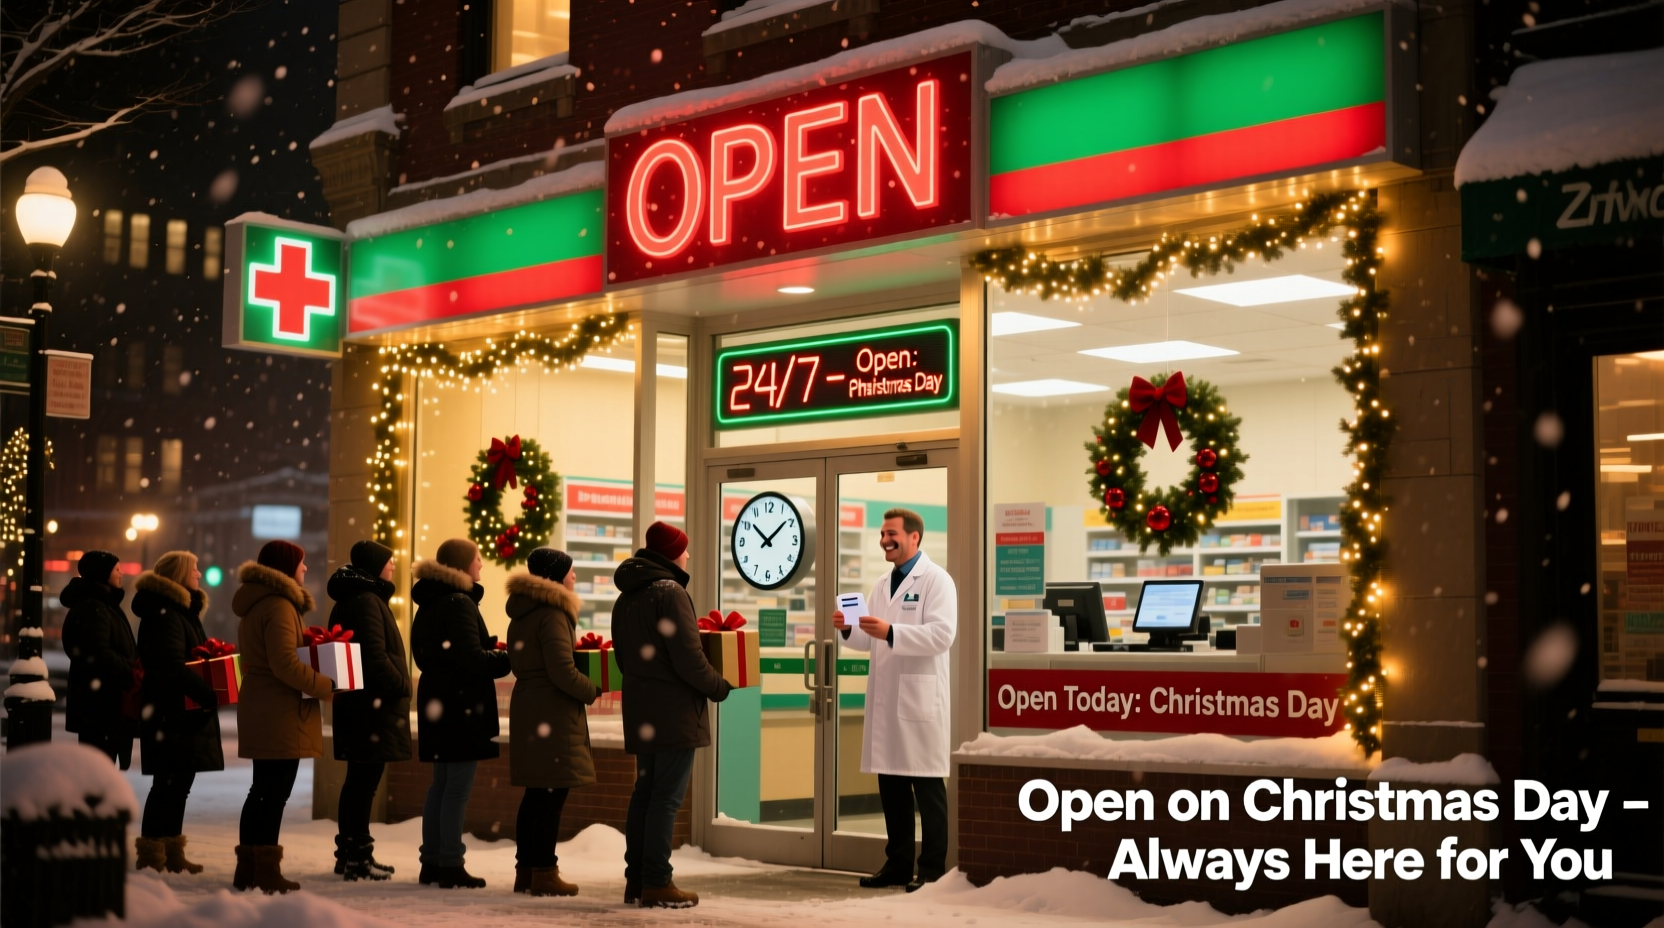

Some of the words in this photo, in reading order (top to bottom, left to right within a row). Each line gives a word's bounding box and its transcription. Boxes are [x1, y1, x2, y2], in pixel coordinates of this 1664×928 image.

[626, 80, 939, 258] OPEN
[856, 348, 918, 376] Open:
[730, 355, 820, 411] 24/7
[915, 371, 943, 395] Day
[764, 501, 774, 513] 12
[997, 684, 1057, 716] Open
[1064, 685, 1141, 720] Today:
[1149, 687, 1279, 718] Christmas
[1288, 690, 1339, 727] Day
